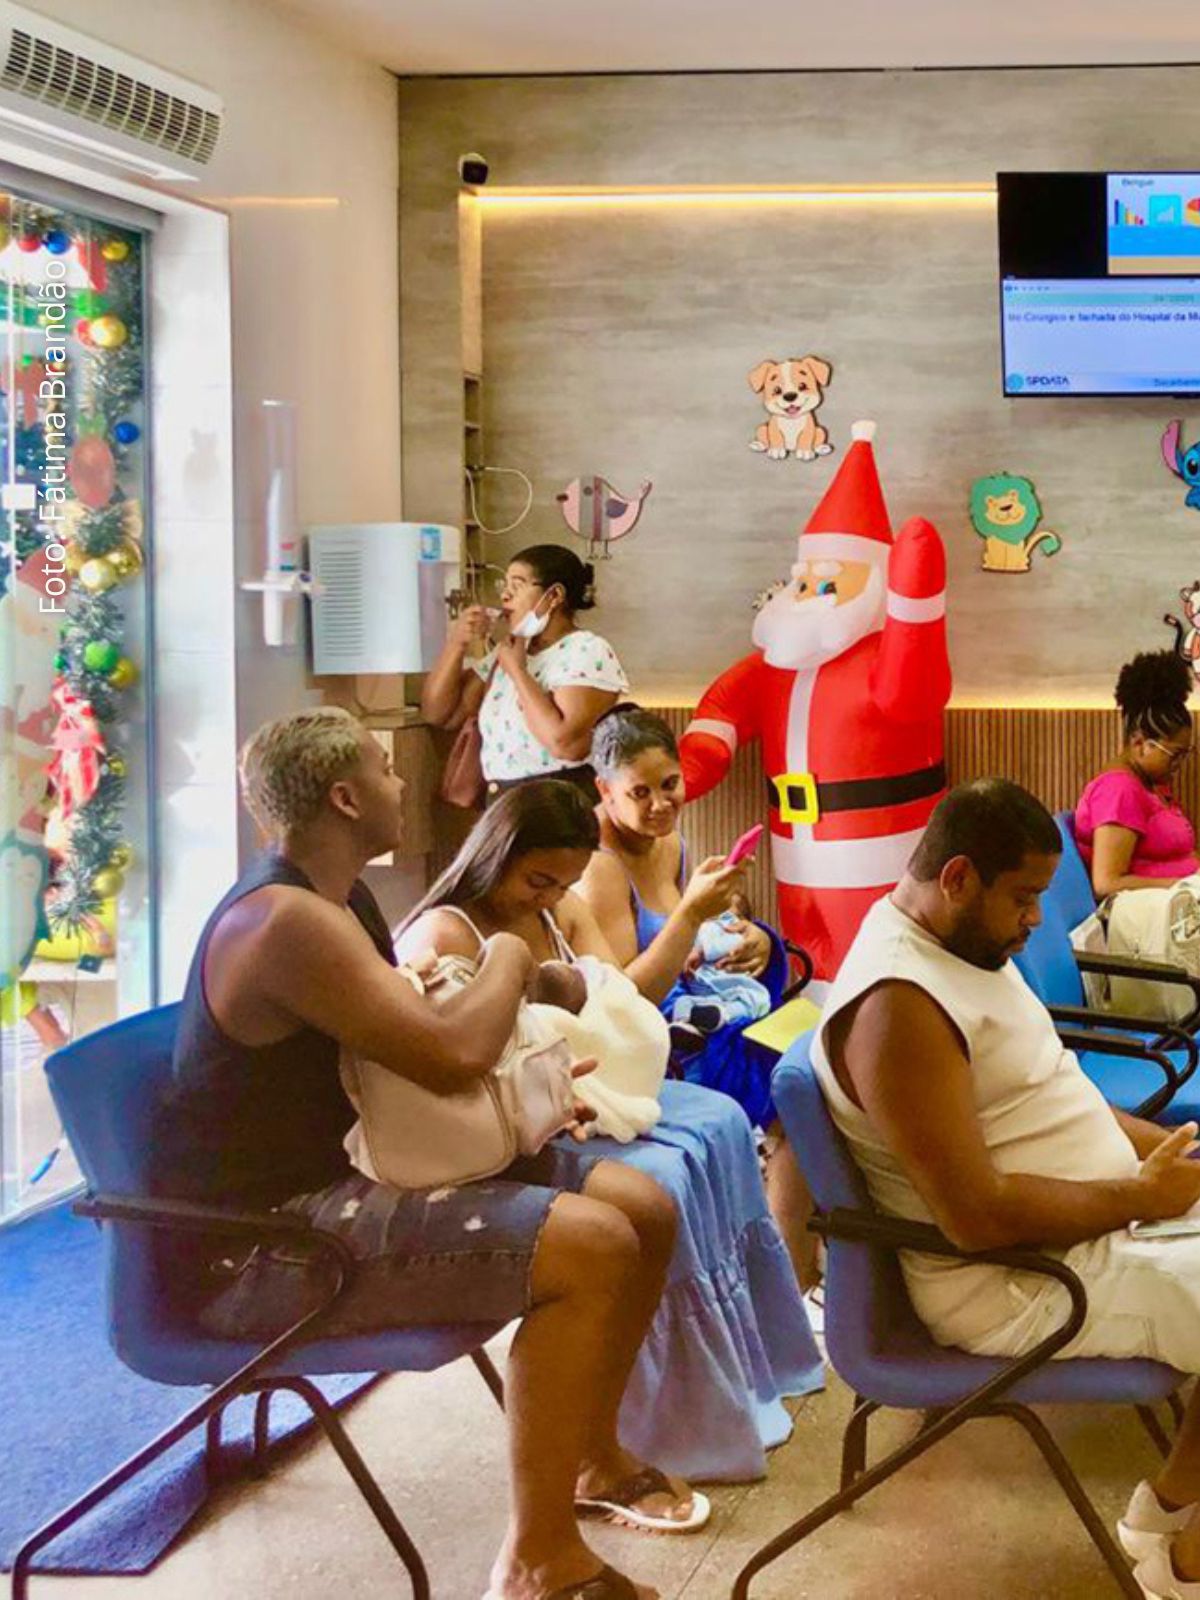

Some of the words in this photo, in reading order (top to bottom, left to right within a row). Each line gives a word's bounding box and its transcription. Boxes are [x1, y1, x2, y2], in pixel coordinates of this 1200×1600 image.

[1133, 310, 1172, 324] Hospital
[1173, 311, 1186, 321] da
[1026, 375, 1070, 385] SPDATA
